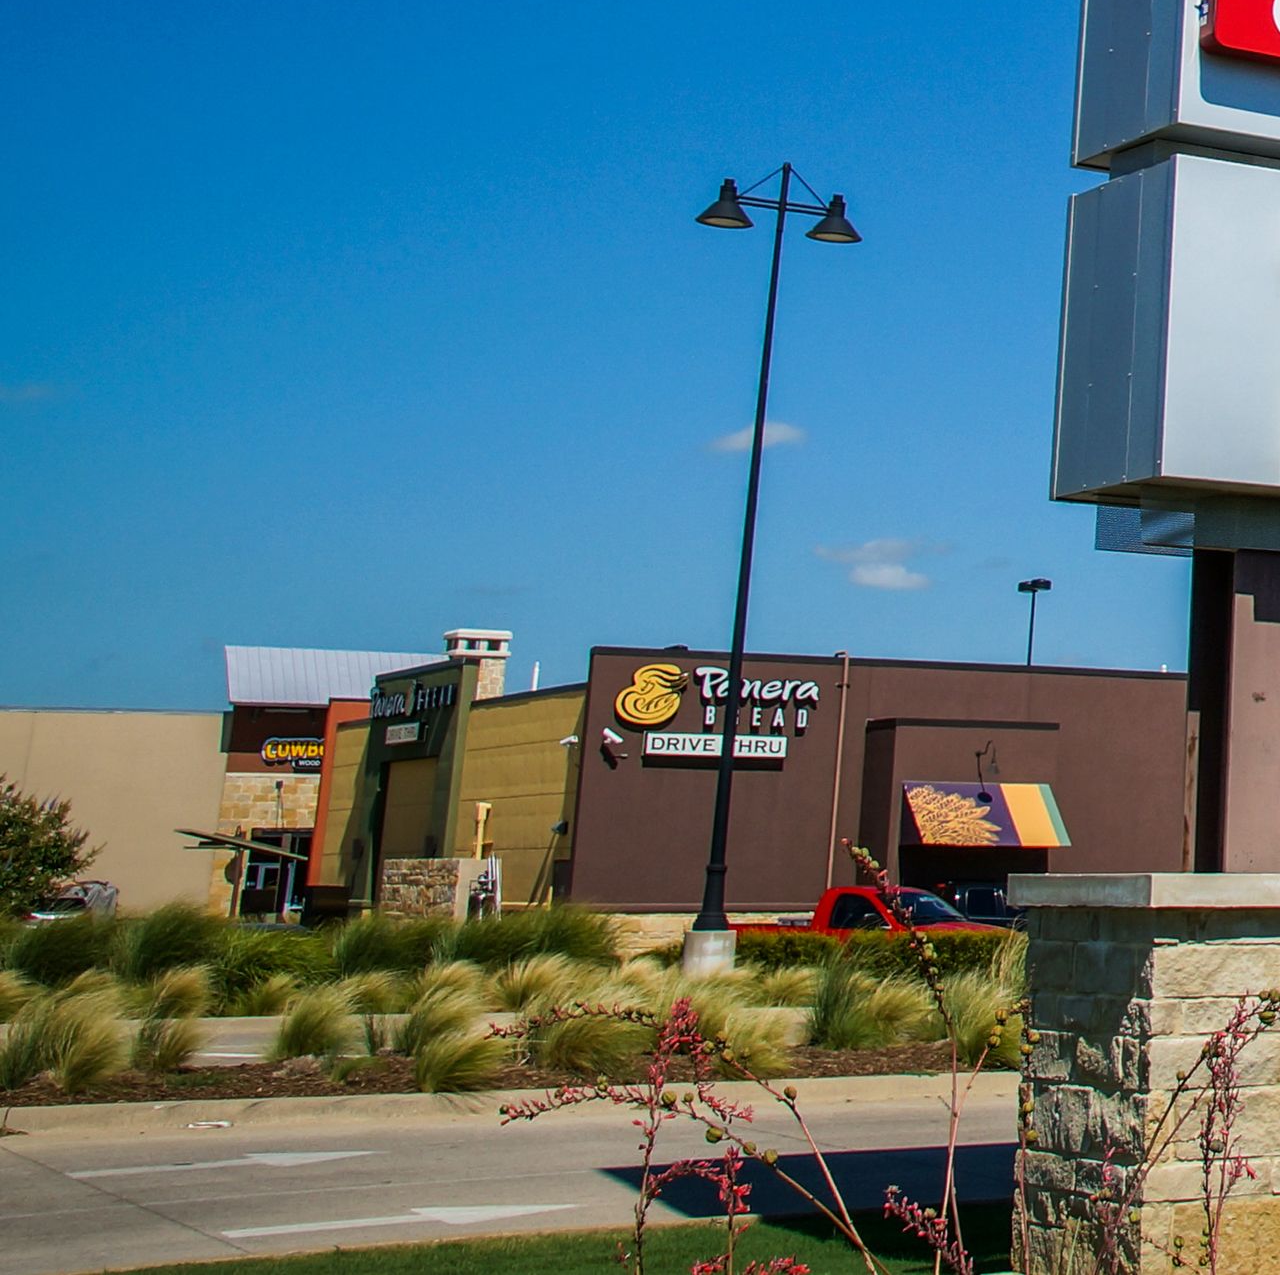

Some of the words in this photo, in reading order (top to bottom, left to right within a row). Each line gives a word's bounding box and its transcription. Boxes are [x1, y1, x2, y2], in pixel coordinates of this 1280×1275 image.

[705, 705, 809, 728] BEAD
[651, 737, 716, 753] DRIVE
[734, 738, 783, 754] HRU
